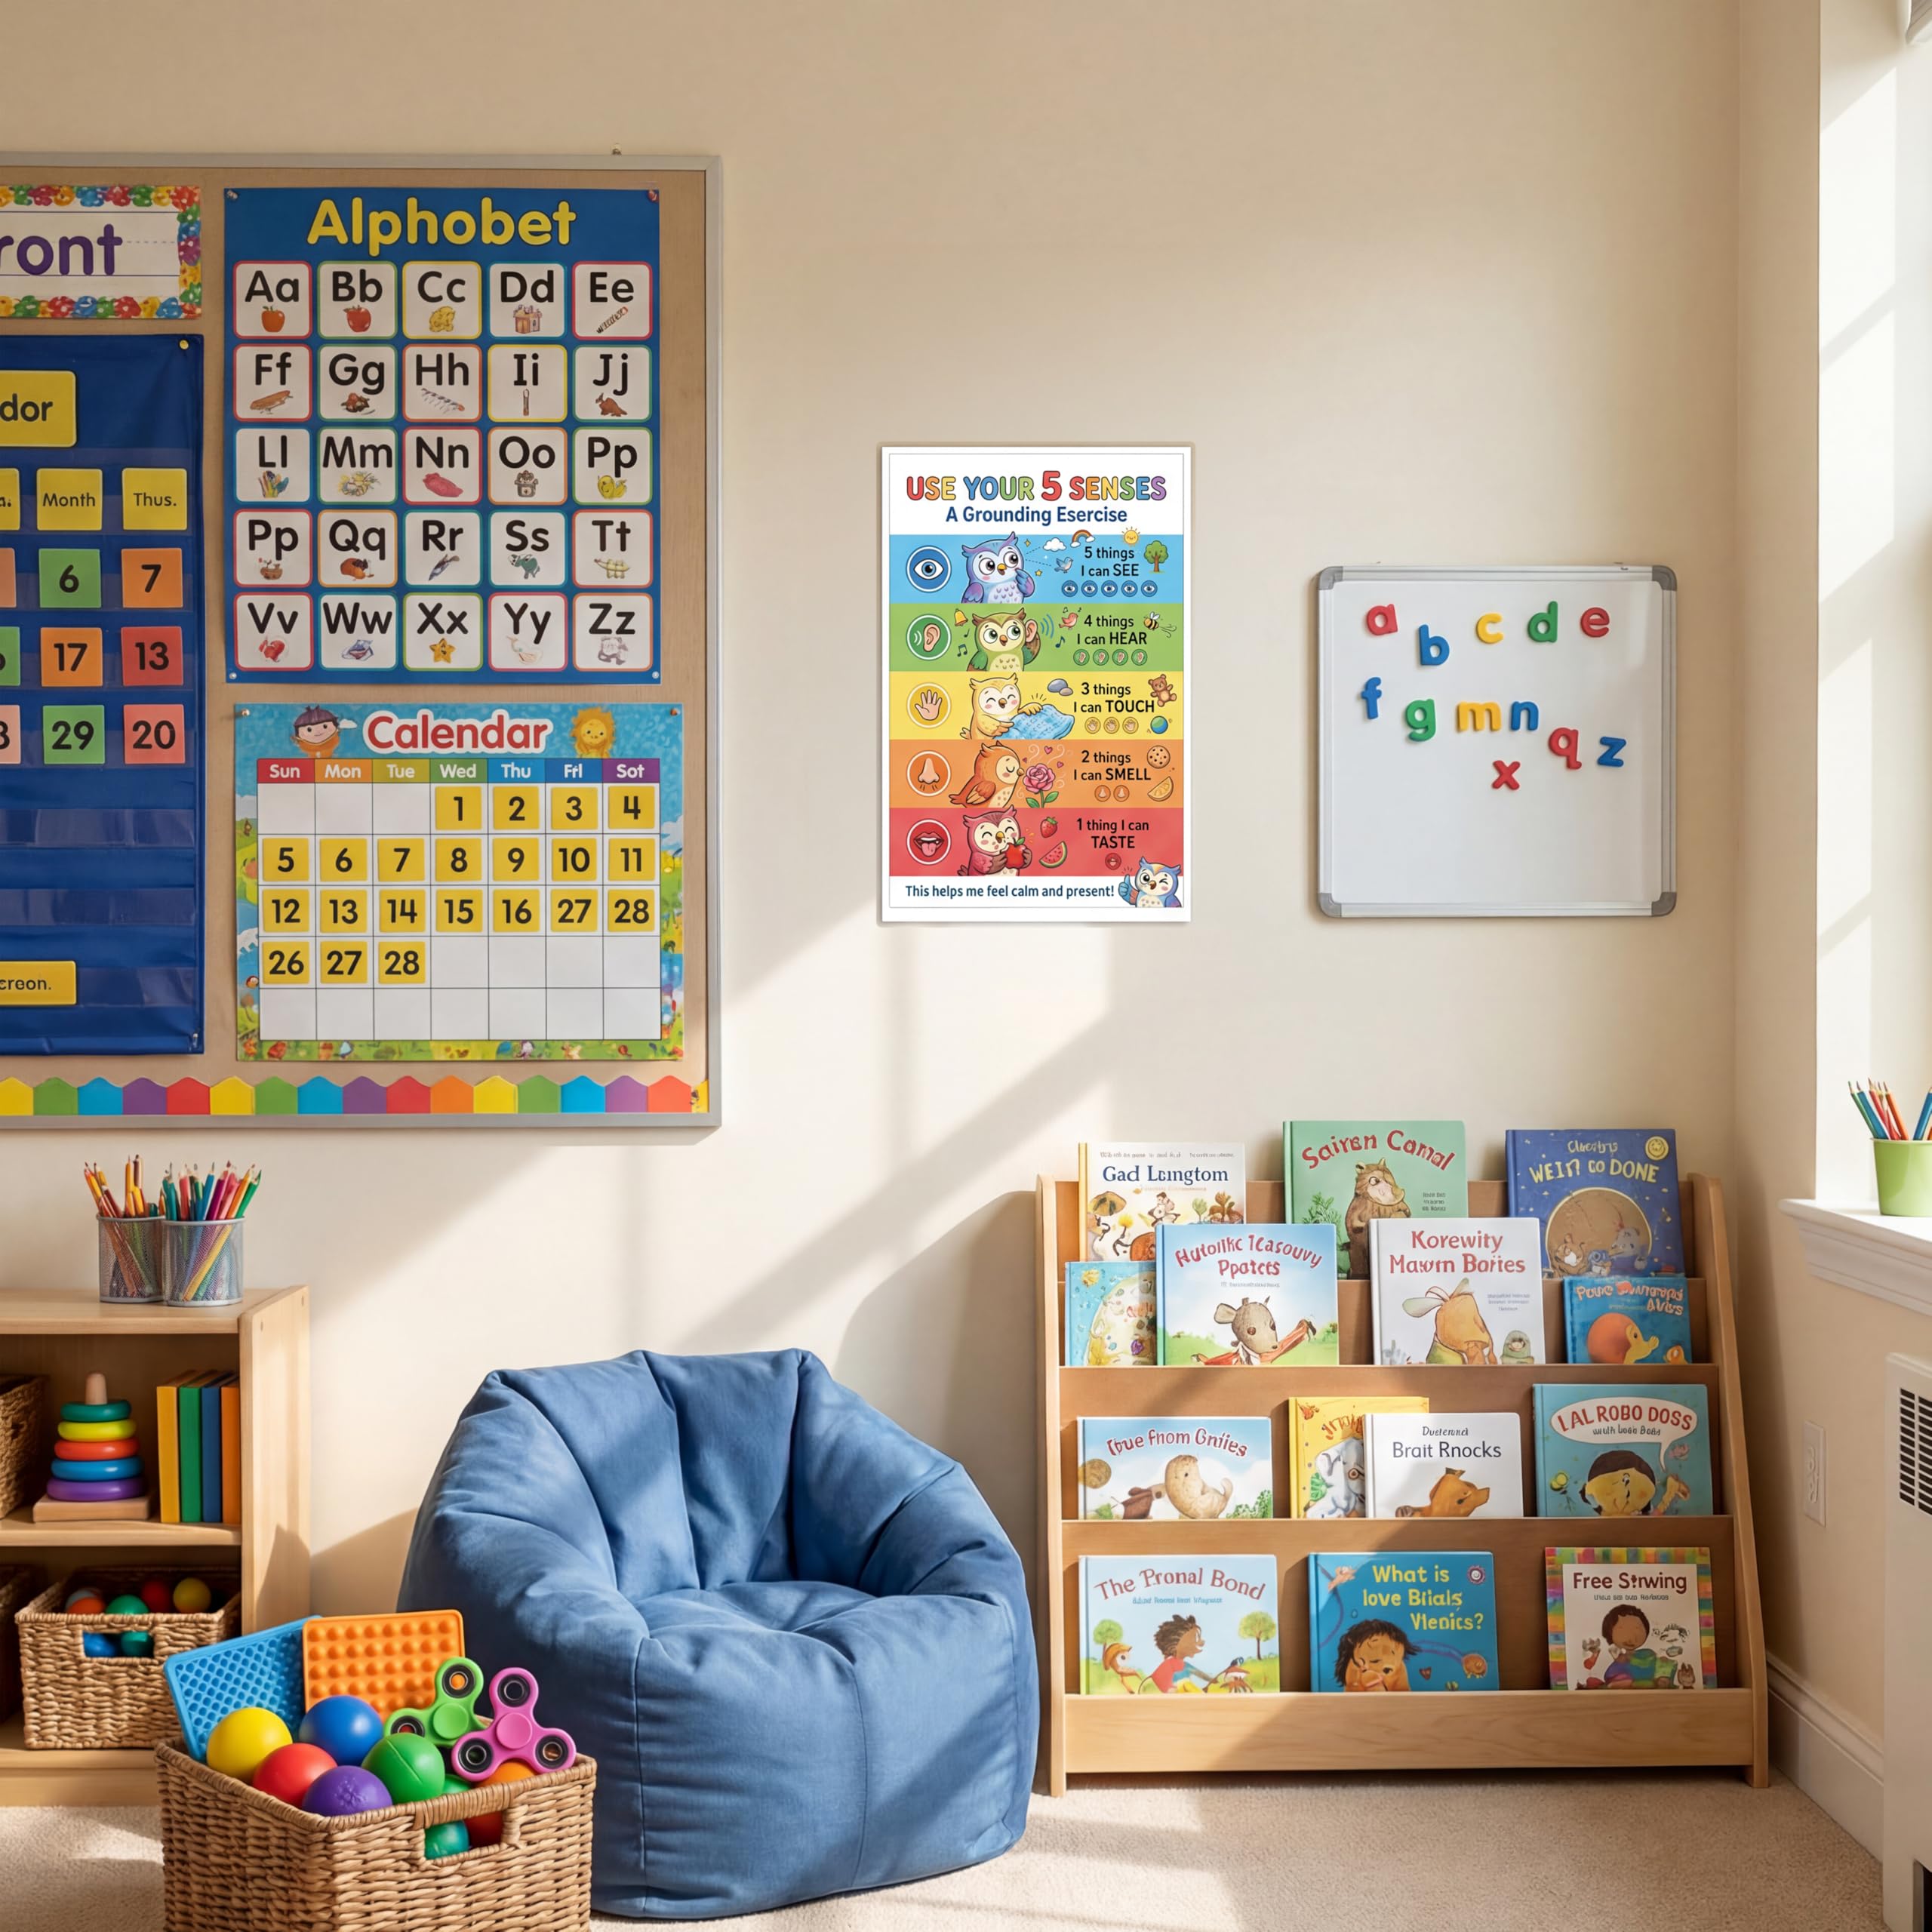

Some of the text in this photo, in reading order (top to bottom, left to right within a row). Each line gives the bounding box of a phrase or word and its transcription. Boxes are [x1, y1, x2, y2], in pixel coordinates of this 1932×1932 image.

[245, 269, 634, 303] Aa Bb Cc Dd Ee
[256, 352, 628, 397] Ff Gg Hh Ii Jj
[259, 435, 637, 478] Ll Mm Nn Oo Pp
[906, 470, 1167, 501] USE YOUR 5 SENSES
[43, 493, 95, 506] Month
[133, 492, 177, 506] Thus.
[946, 506, 958, 521] A
[963, 506, 1051, 526] Grounding
[249, 519, 631, 561] Pp Qq Rr Ss Tt
[1084, 546, 1134, 561] 5 things
[60, 565, 162, 592] 6 7
[1080, 563, 1085, 577] I
[1113, 564, 1139, 576] SEE
[248, 602, 635, 645] Vv Ww Xx Yy Zz
[1084, 615, 1134, 630] 4 things
[1366, 600, 1610, 666] a b c d e
[1076, 632, 1146, 645] I can HEAR
[54, 641, 169, 671] 17 13
[1081, 682, 1131, 698] 3 things
[1073, 700, 1154, 713] I can TOUCH
[366, 713, 550, 750] Calendar
[1361, 676, 1626, 770] f g m n q z
[52, 721, 94, 750] 29
[133, 721, 175, 749] 20
[270, 764, 300, 778] Sun
[325, 764, 361, 778] Mon
[386, 764, 415, 778] Tue
[440, 764, 476, 778] Wed
[501, 762, 531, 778] Thu
[1081, 750, 1131, 766] 2 things
[1073, 768, 1078, 781] I
[1106, 768, 1151, 780] SMELL
[1492, 760, 1521, 790] x
[454, 796, 641, 821] 1 2 3 4
[1077, 818, 1081, 830] 1
[1087, 820, 1117, 833] thing
[1122, 820, 1124, 830] I
[1091, 835, 1135, 848] TASTE
[278, 848, 641, 872] 5 6 7 8 9 10 11
[906, 885, 1114, 900] This helps me feel calm and present!
[272, 899, 649, 924] 12 13 14 15 16 27 28
[269, 950, 419, 975] 26 27 28
[1103, 1165, 1140, 1181] Gad
[1609, 1158, 1660, 1183] DONE
[1412, 1230, 1503, 1254] Korewity
[1648, 1406, 1693, 1431] DOSS
[1393, 1442, 1433, 1457] Brait
[1094, 1579, 1136, 1601] The
[1211, 1570, 1266, 1601] Bond
[1372, 1564, 1450, 1583] What is
[1573, 1572, 1613, 1589] Free
[1363, 1589, 1401, 1606] love
